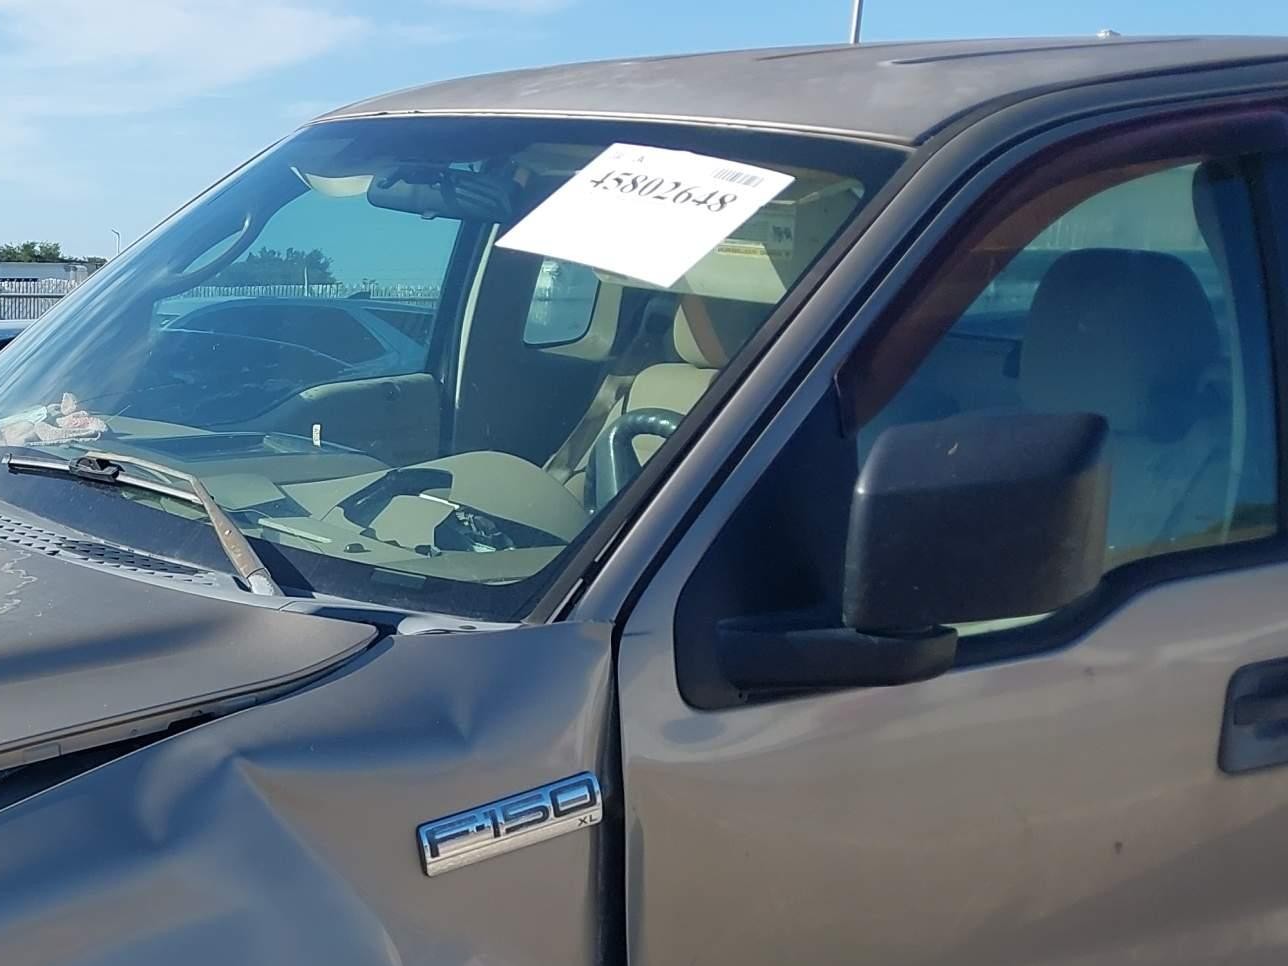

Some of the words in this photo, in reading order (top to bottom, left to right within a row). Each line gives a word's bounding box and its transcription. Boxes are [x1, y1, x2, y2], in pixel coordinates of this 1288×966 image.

[590, 170, 738, 212] 45802648
[425, 778, 597, 858] F-150
[577, 814, 597, 827] XL
